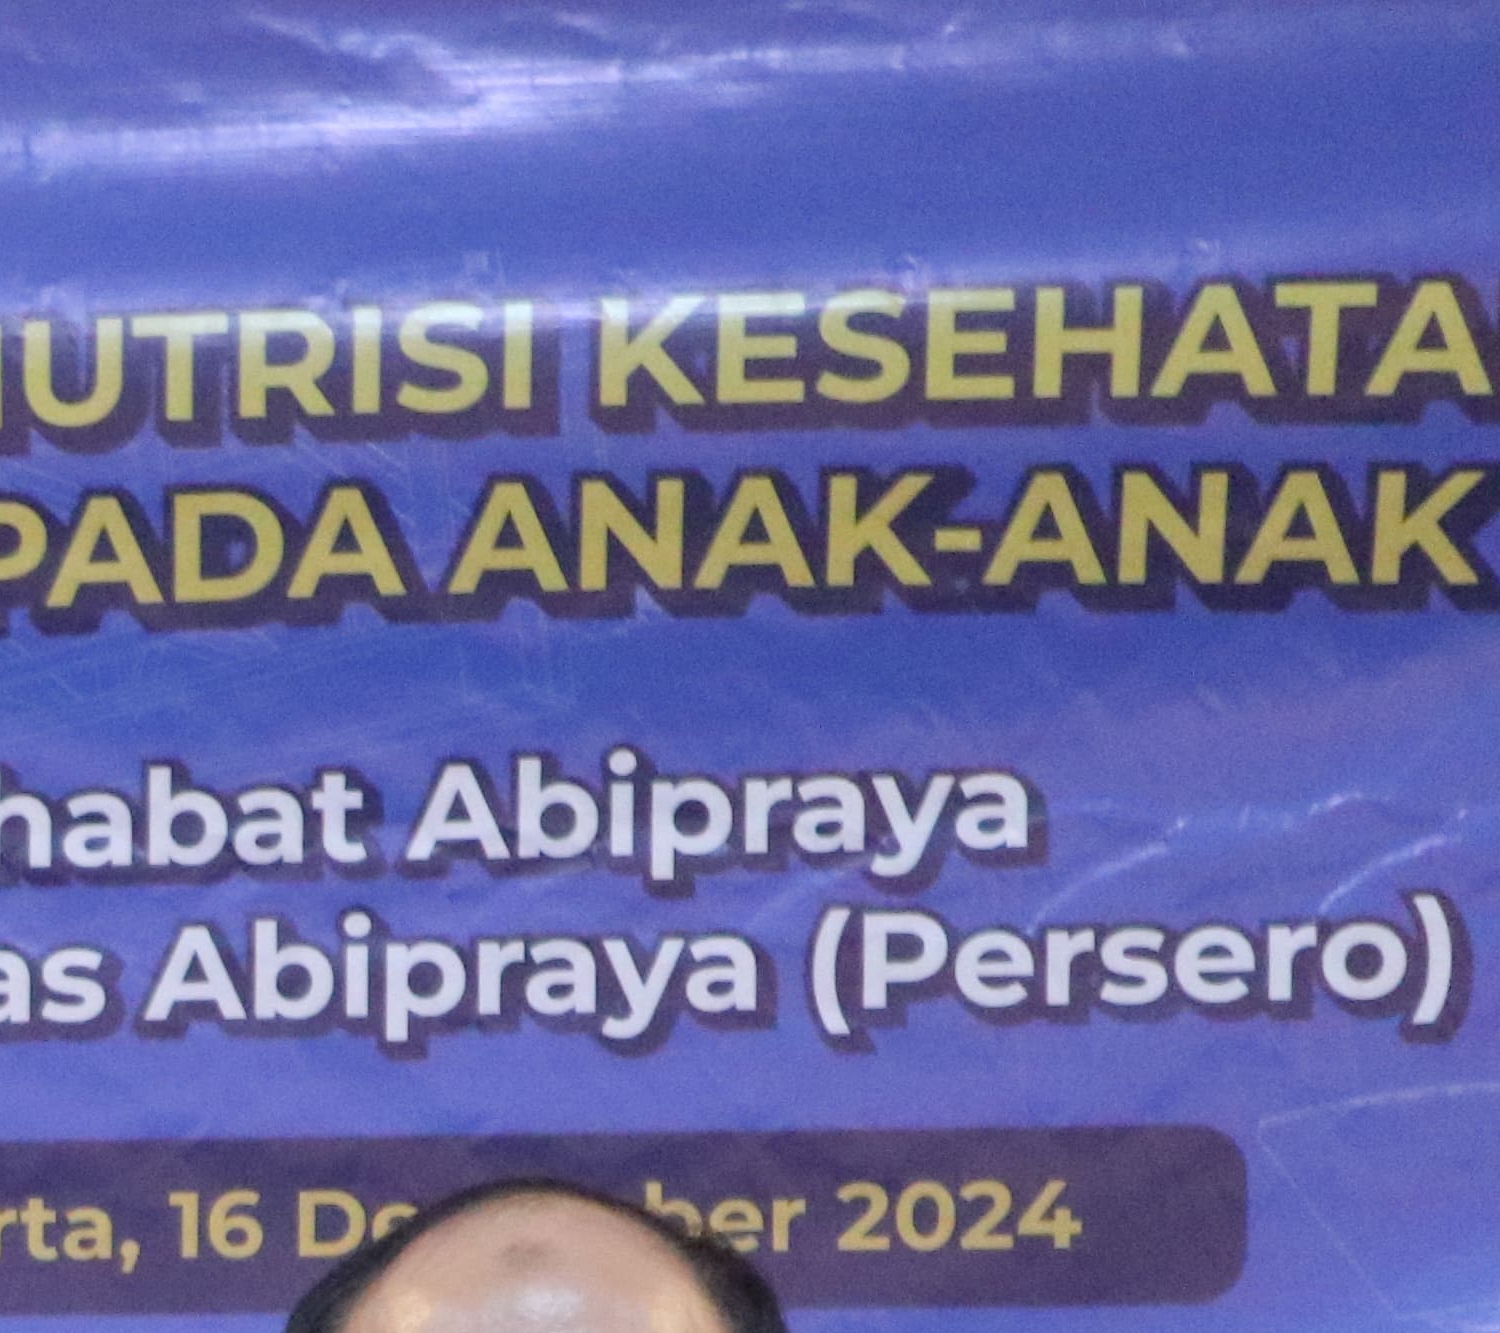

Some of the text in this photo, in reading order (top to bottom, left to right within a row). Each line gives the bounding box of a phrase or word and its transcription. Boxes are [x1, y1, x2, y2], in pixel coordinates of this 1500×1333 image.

[598, 281, 1494, 406] KESEHATA
[449, 470, 1484, 594] ANAK-ANAK
[406, 750, 1029, 880] Abipraya
[143, 913, 759, 1042] Abipraya
[811, 895, 1453, 1035] (Persero)
[169, 1189, 263, 1259] 16
[298, 1180, 807, 1258] Dber
[838, 1179, 1082, 1252] 2024
